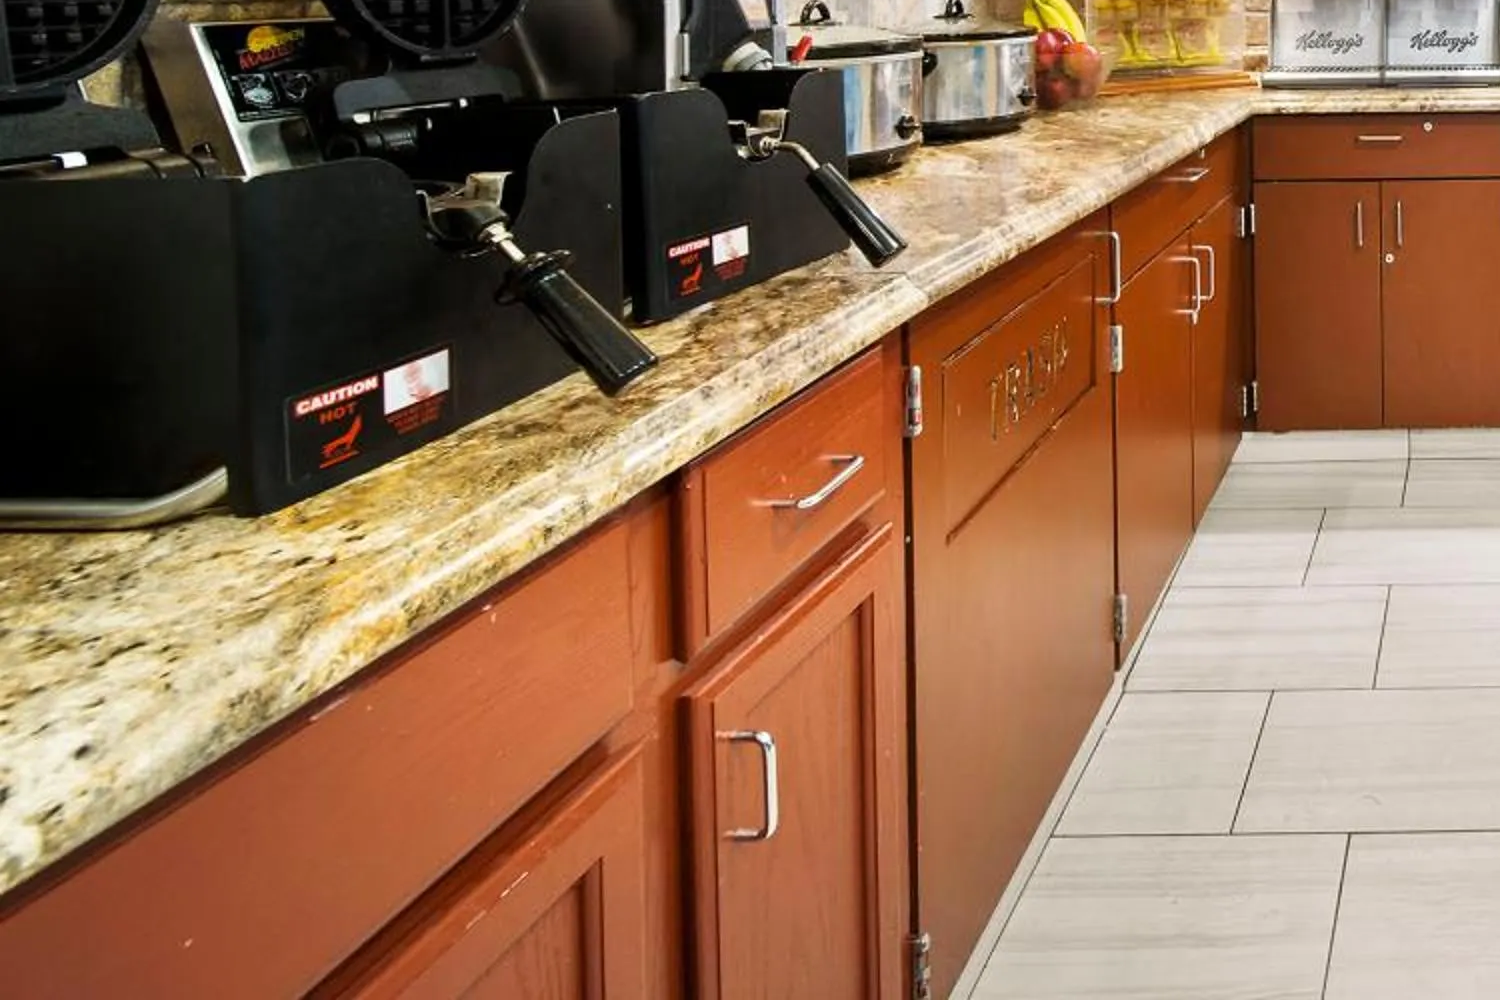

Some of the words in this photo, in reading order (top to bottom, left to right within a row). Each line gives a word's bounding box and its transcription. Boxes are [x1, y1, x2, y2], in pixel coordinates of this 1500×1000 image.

[1296, 29, 1364, 54] Kellogg's
[1409, 29, 1479, 53] Kellogg's
[295, 375, 380, 416] CAUTION
[318, 401, 358, 425] HOT
